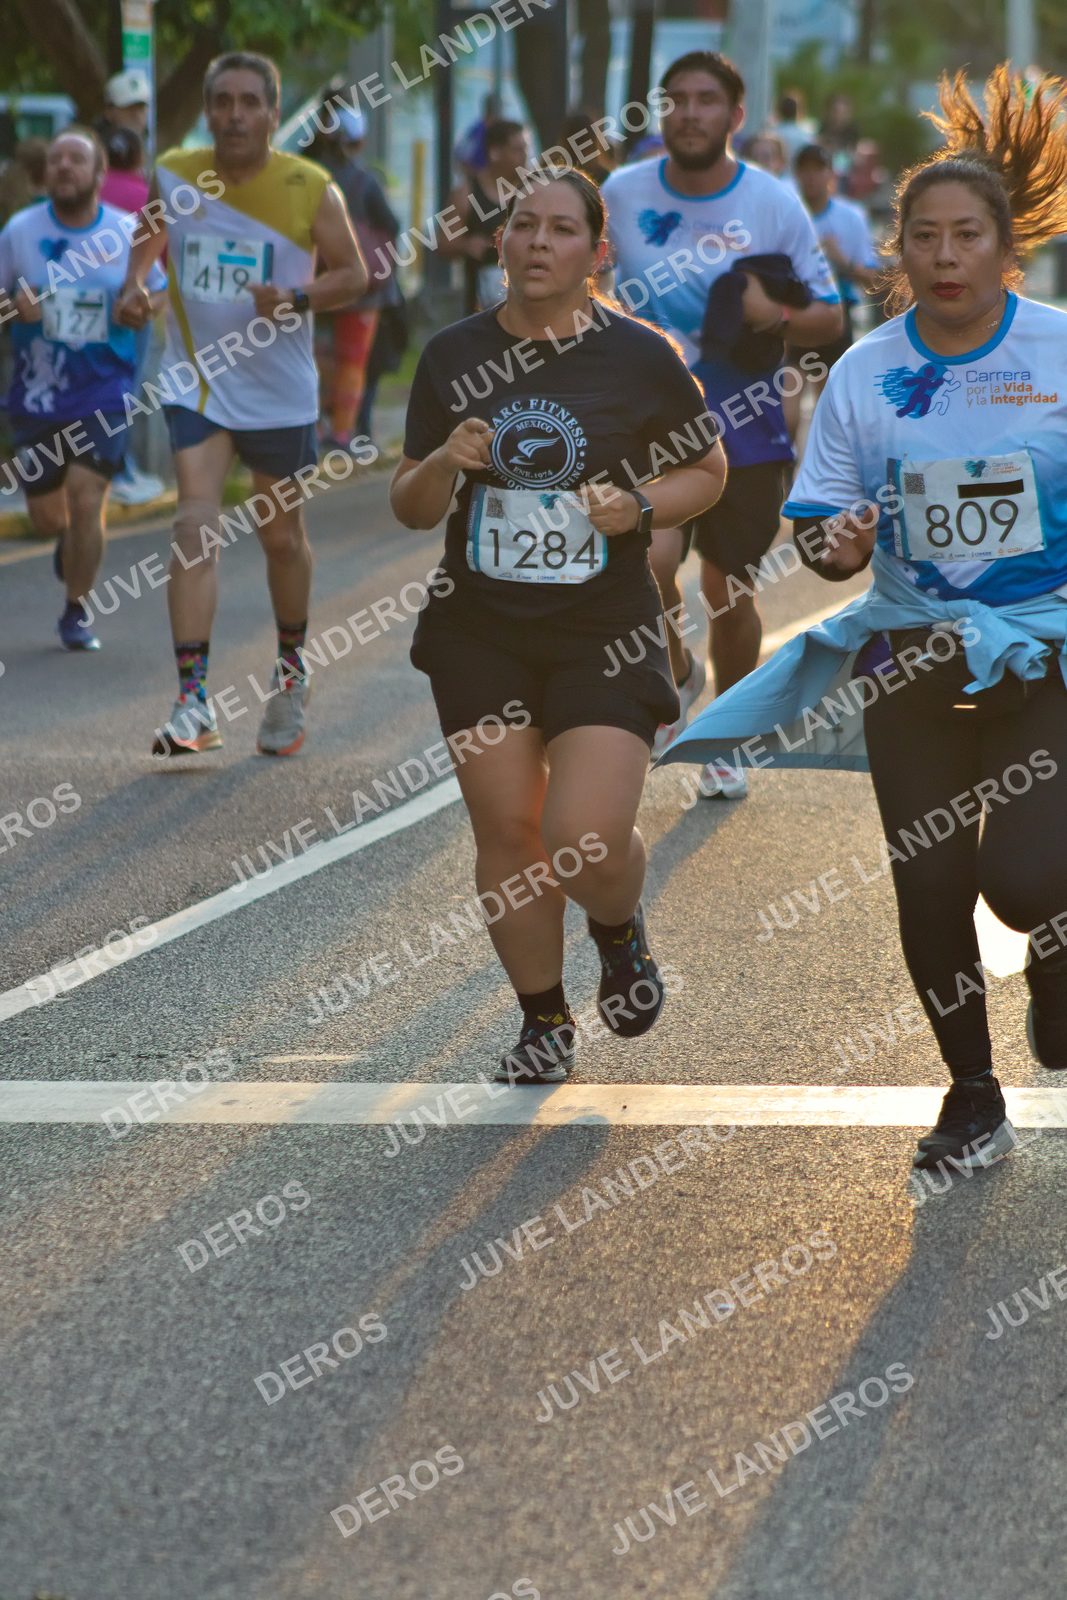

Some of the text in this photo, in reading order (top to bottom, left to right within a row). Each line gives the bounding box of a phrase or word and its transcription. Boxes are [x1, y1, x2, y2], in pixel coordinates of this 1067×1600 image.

[193, 265, 249, 296] 419
[966, 370, 1031, 382] Carrera
[966, 382, 1033, 395] por la Vida
[966, 393, 1058, 407] y la Integridad
[516, 420, 554, 434] MEXICO
[529, 399, 587, 448] FITNESS
[925, 499, 1019, 548] 809
[488, 528, 599, 570] 1284
